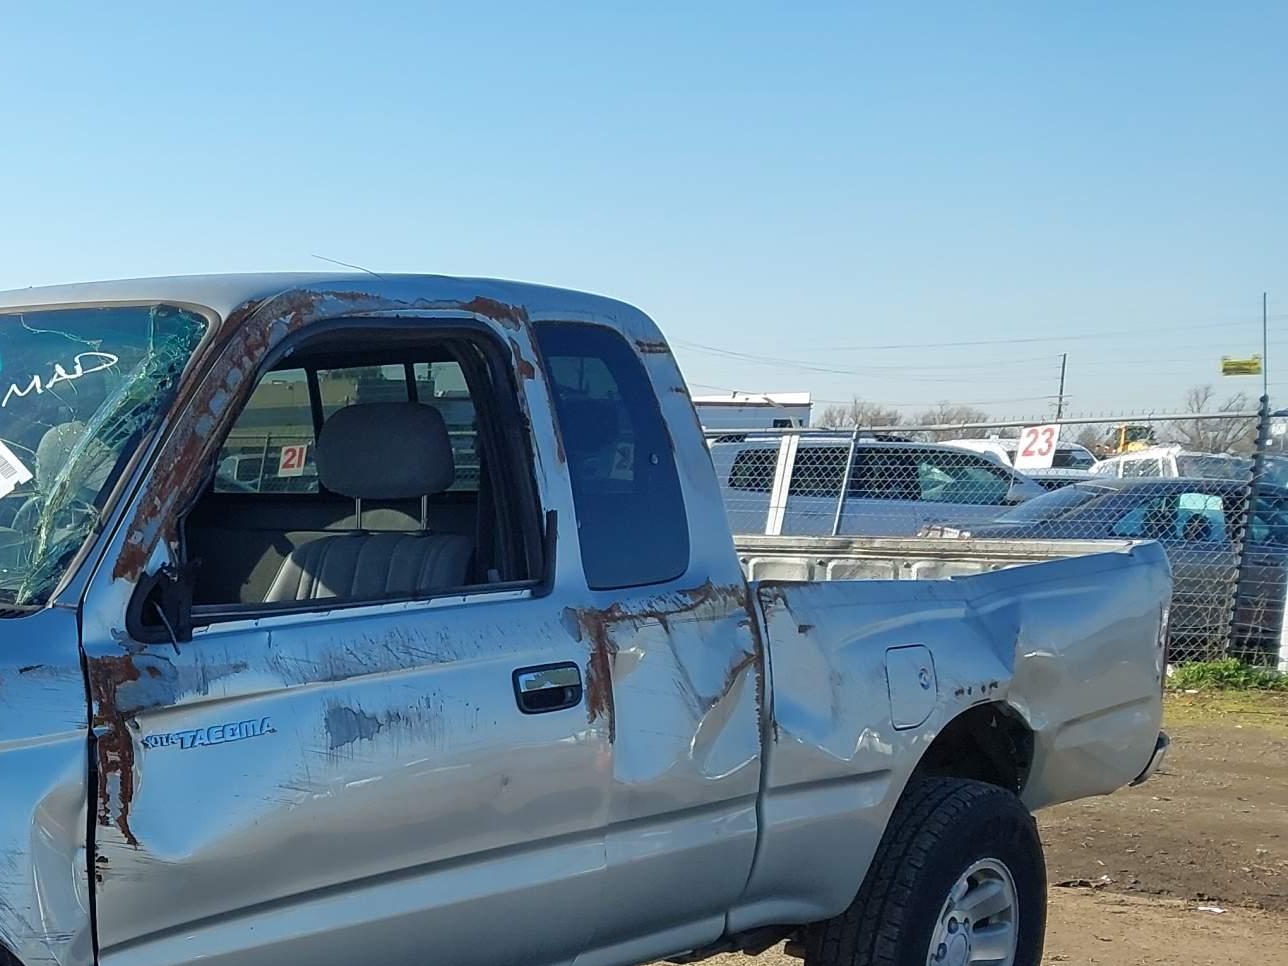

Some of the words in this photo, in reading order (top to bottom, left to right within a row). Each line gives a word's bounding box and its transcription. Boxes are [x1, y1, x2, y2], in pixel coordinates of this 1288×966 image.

[1, 351, 119, 407] MAD
[1021, 427, 1055, 456] 23
[281, 447, 304, 469] 21
[176, 716, 276, 749] TACOMA
